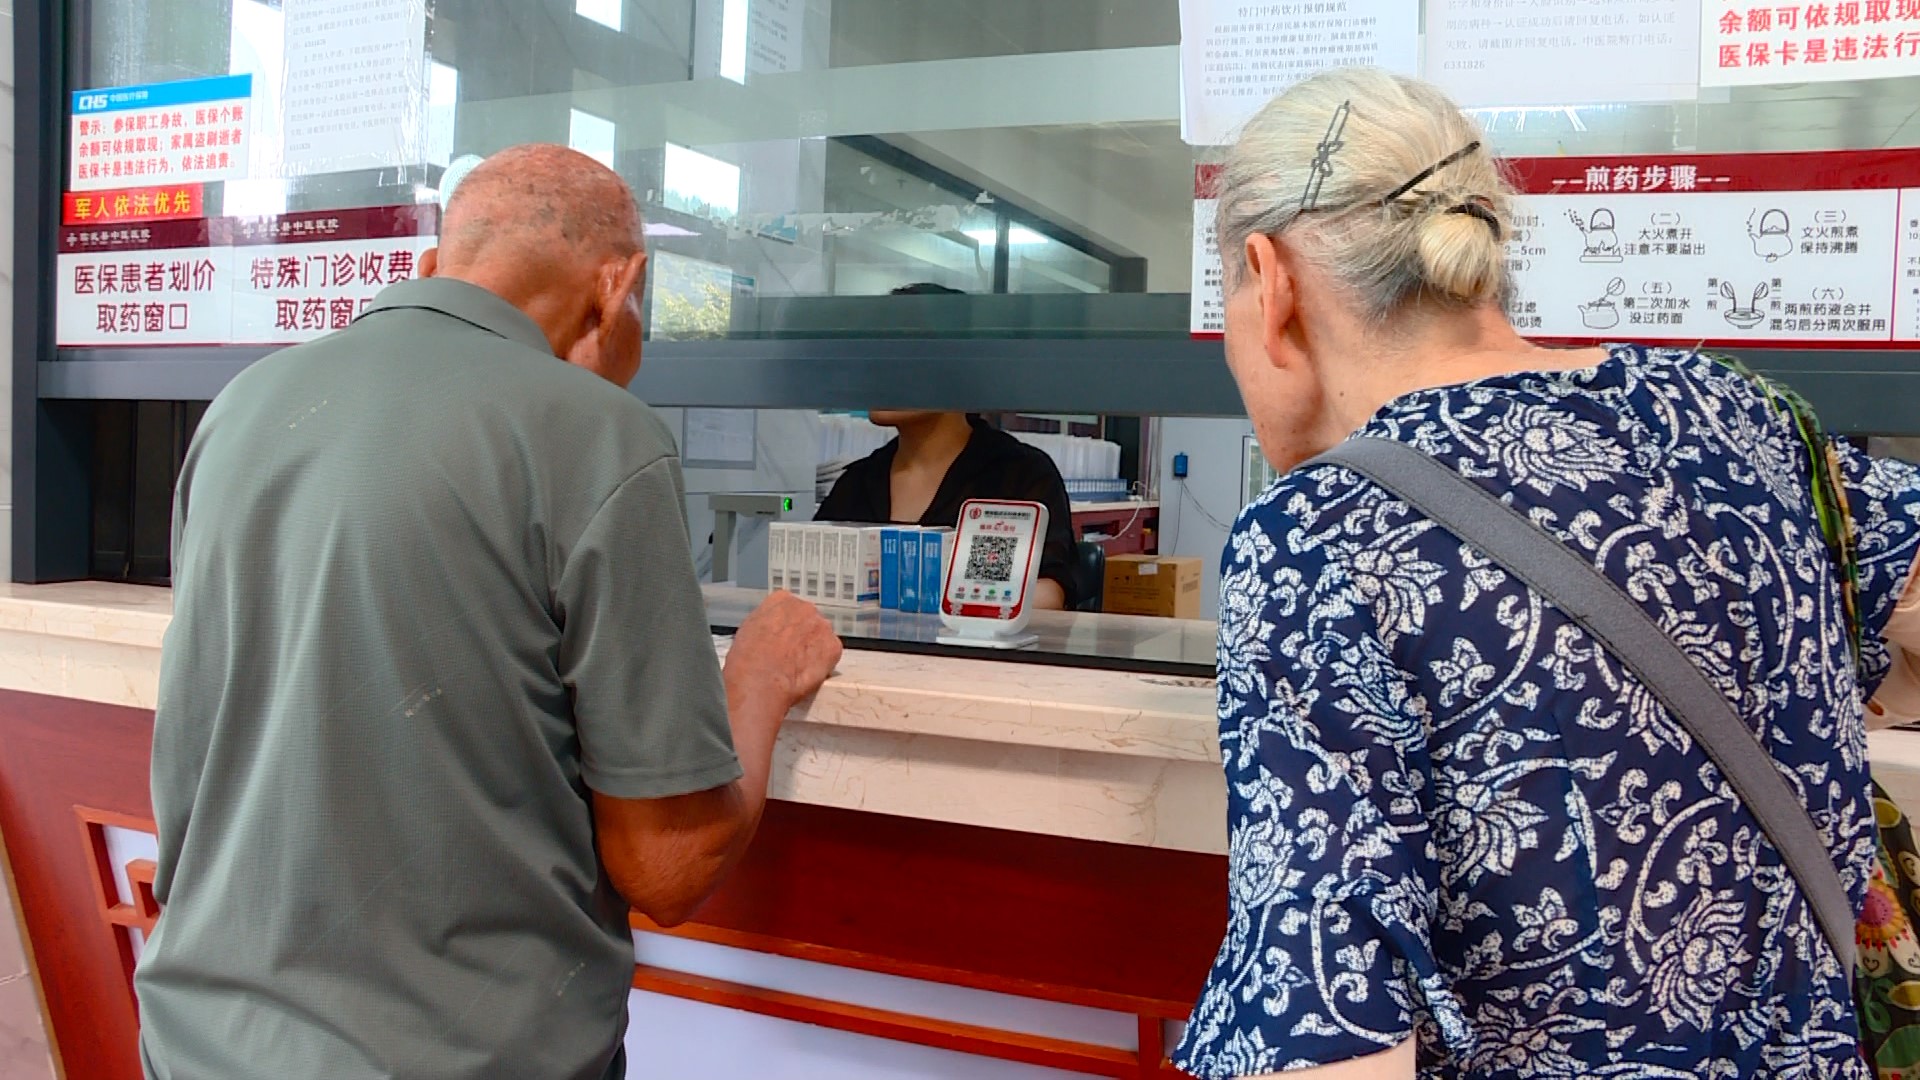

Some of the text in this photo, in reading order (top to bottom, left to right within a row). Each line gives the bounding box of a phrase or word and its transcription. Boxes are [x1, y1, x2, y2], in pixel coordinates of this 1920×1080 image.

[1719, 0, 1920, 34] 余额可依规取现
[1719, 31, 1920, 68] 医保卡是违法行
[75, 191, 191, 220] 军人依法优先
[1639, 228, 1692, 240] 大火煮开
[1801, 225, 1859, 238] 文火煎煮
[1624, 243, 1705, 256] 注意不要溢出
[1800, 241, 1859, 254] 保持沸腾
[250, 250, 414, 289] 特殊门诊收费
[75, 259, 215, 294] 医保患者划价
[1624, 297, 1690, 309] 第二次加水
[1784, 303, 1872, 316] 两煎药液合并
[96, 302, 188, 333] 取药窗口
[1630, 312, 1682, 324] 没过药面
[1769, 318, 1886, 332] 混匀后分两次服用
